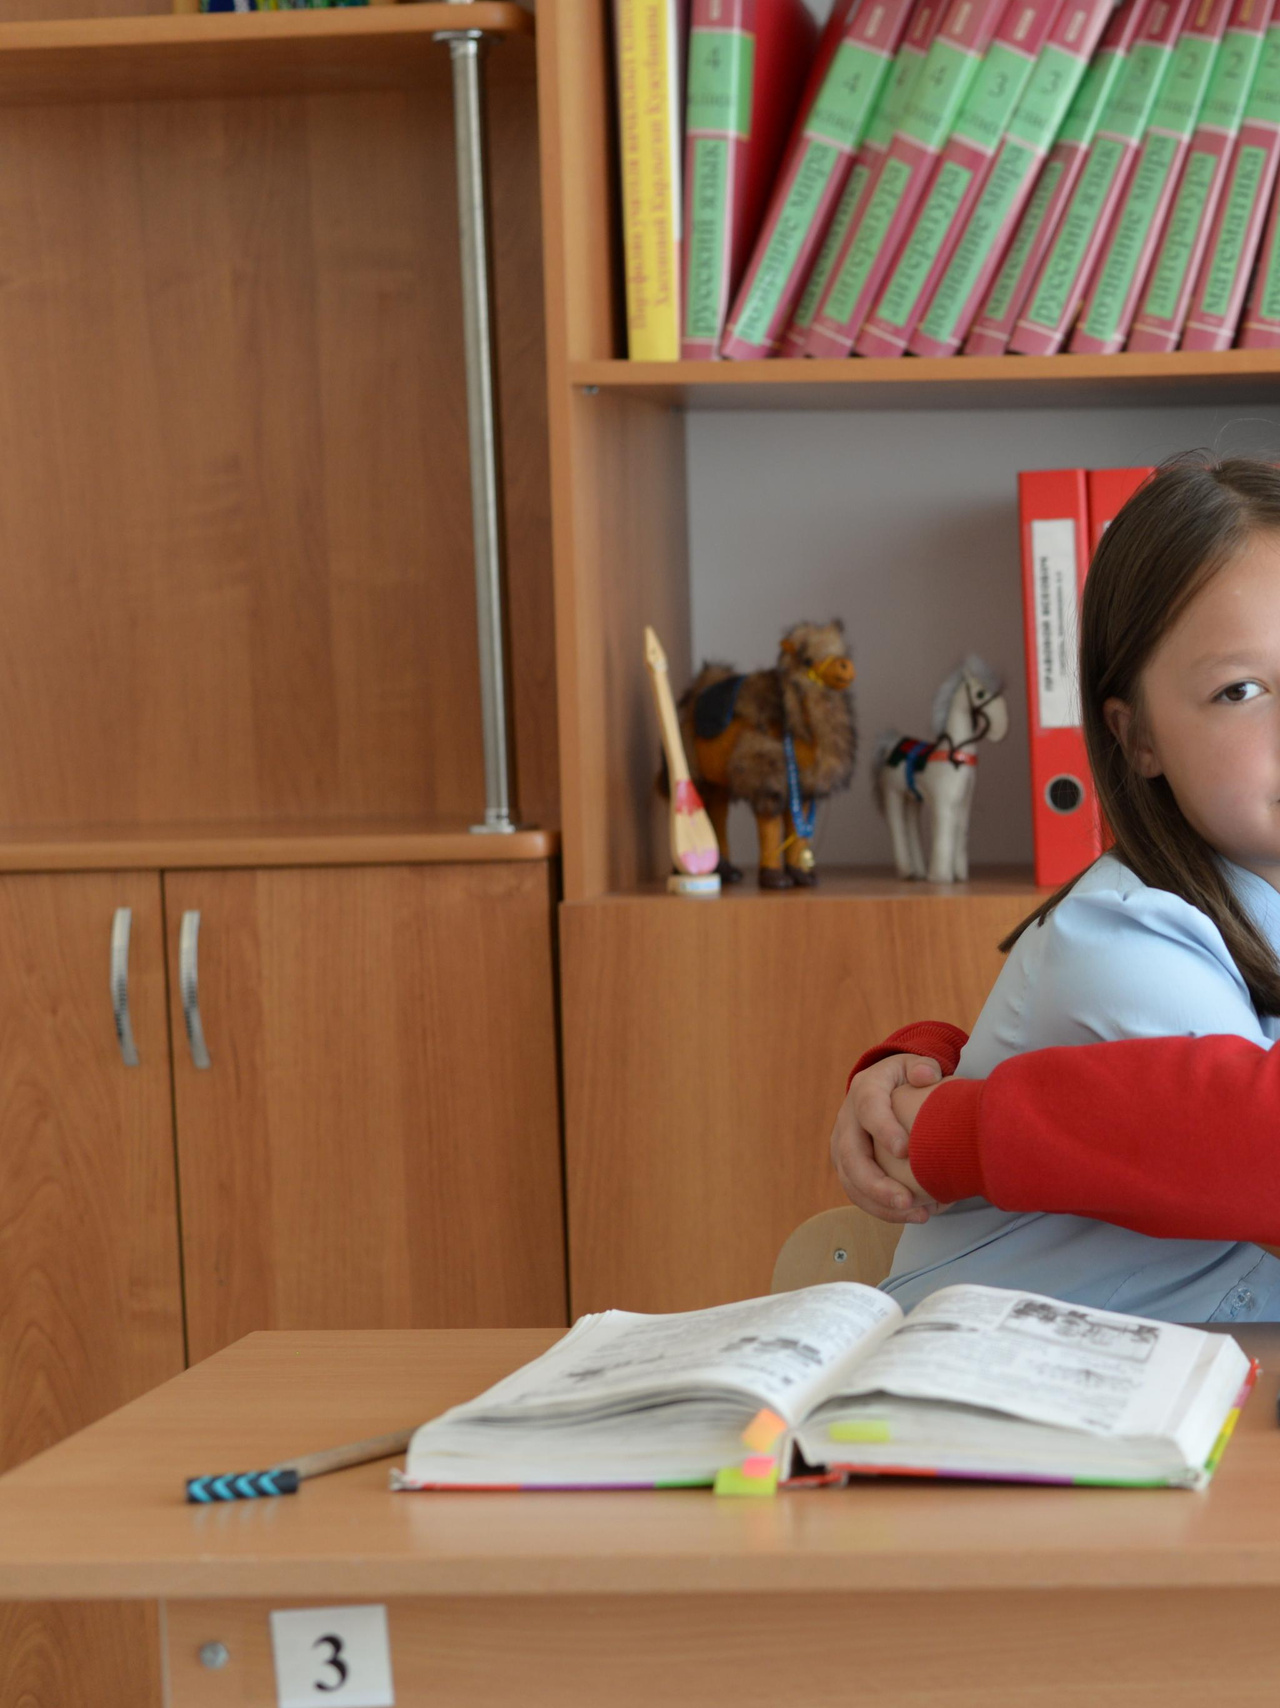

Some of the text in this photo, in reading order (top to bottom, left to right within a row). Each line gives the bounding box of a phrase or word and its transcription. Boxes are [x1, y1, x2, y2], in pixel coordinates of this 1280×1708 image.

[922, 213, 993, 338] познание
[980, 141, 1032, 215] мира
[1029, 209, 1094, 324] русский
[1087, 207, 1144, 336] познание
[1130, 131, 1177, 207] мира
[1201, 148, 1262, 312] математика
[311, 1632, 349, 1693] 3
